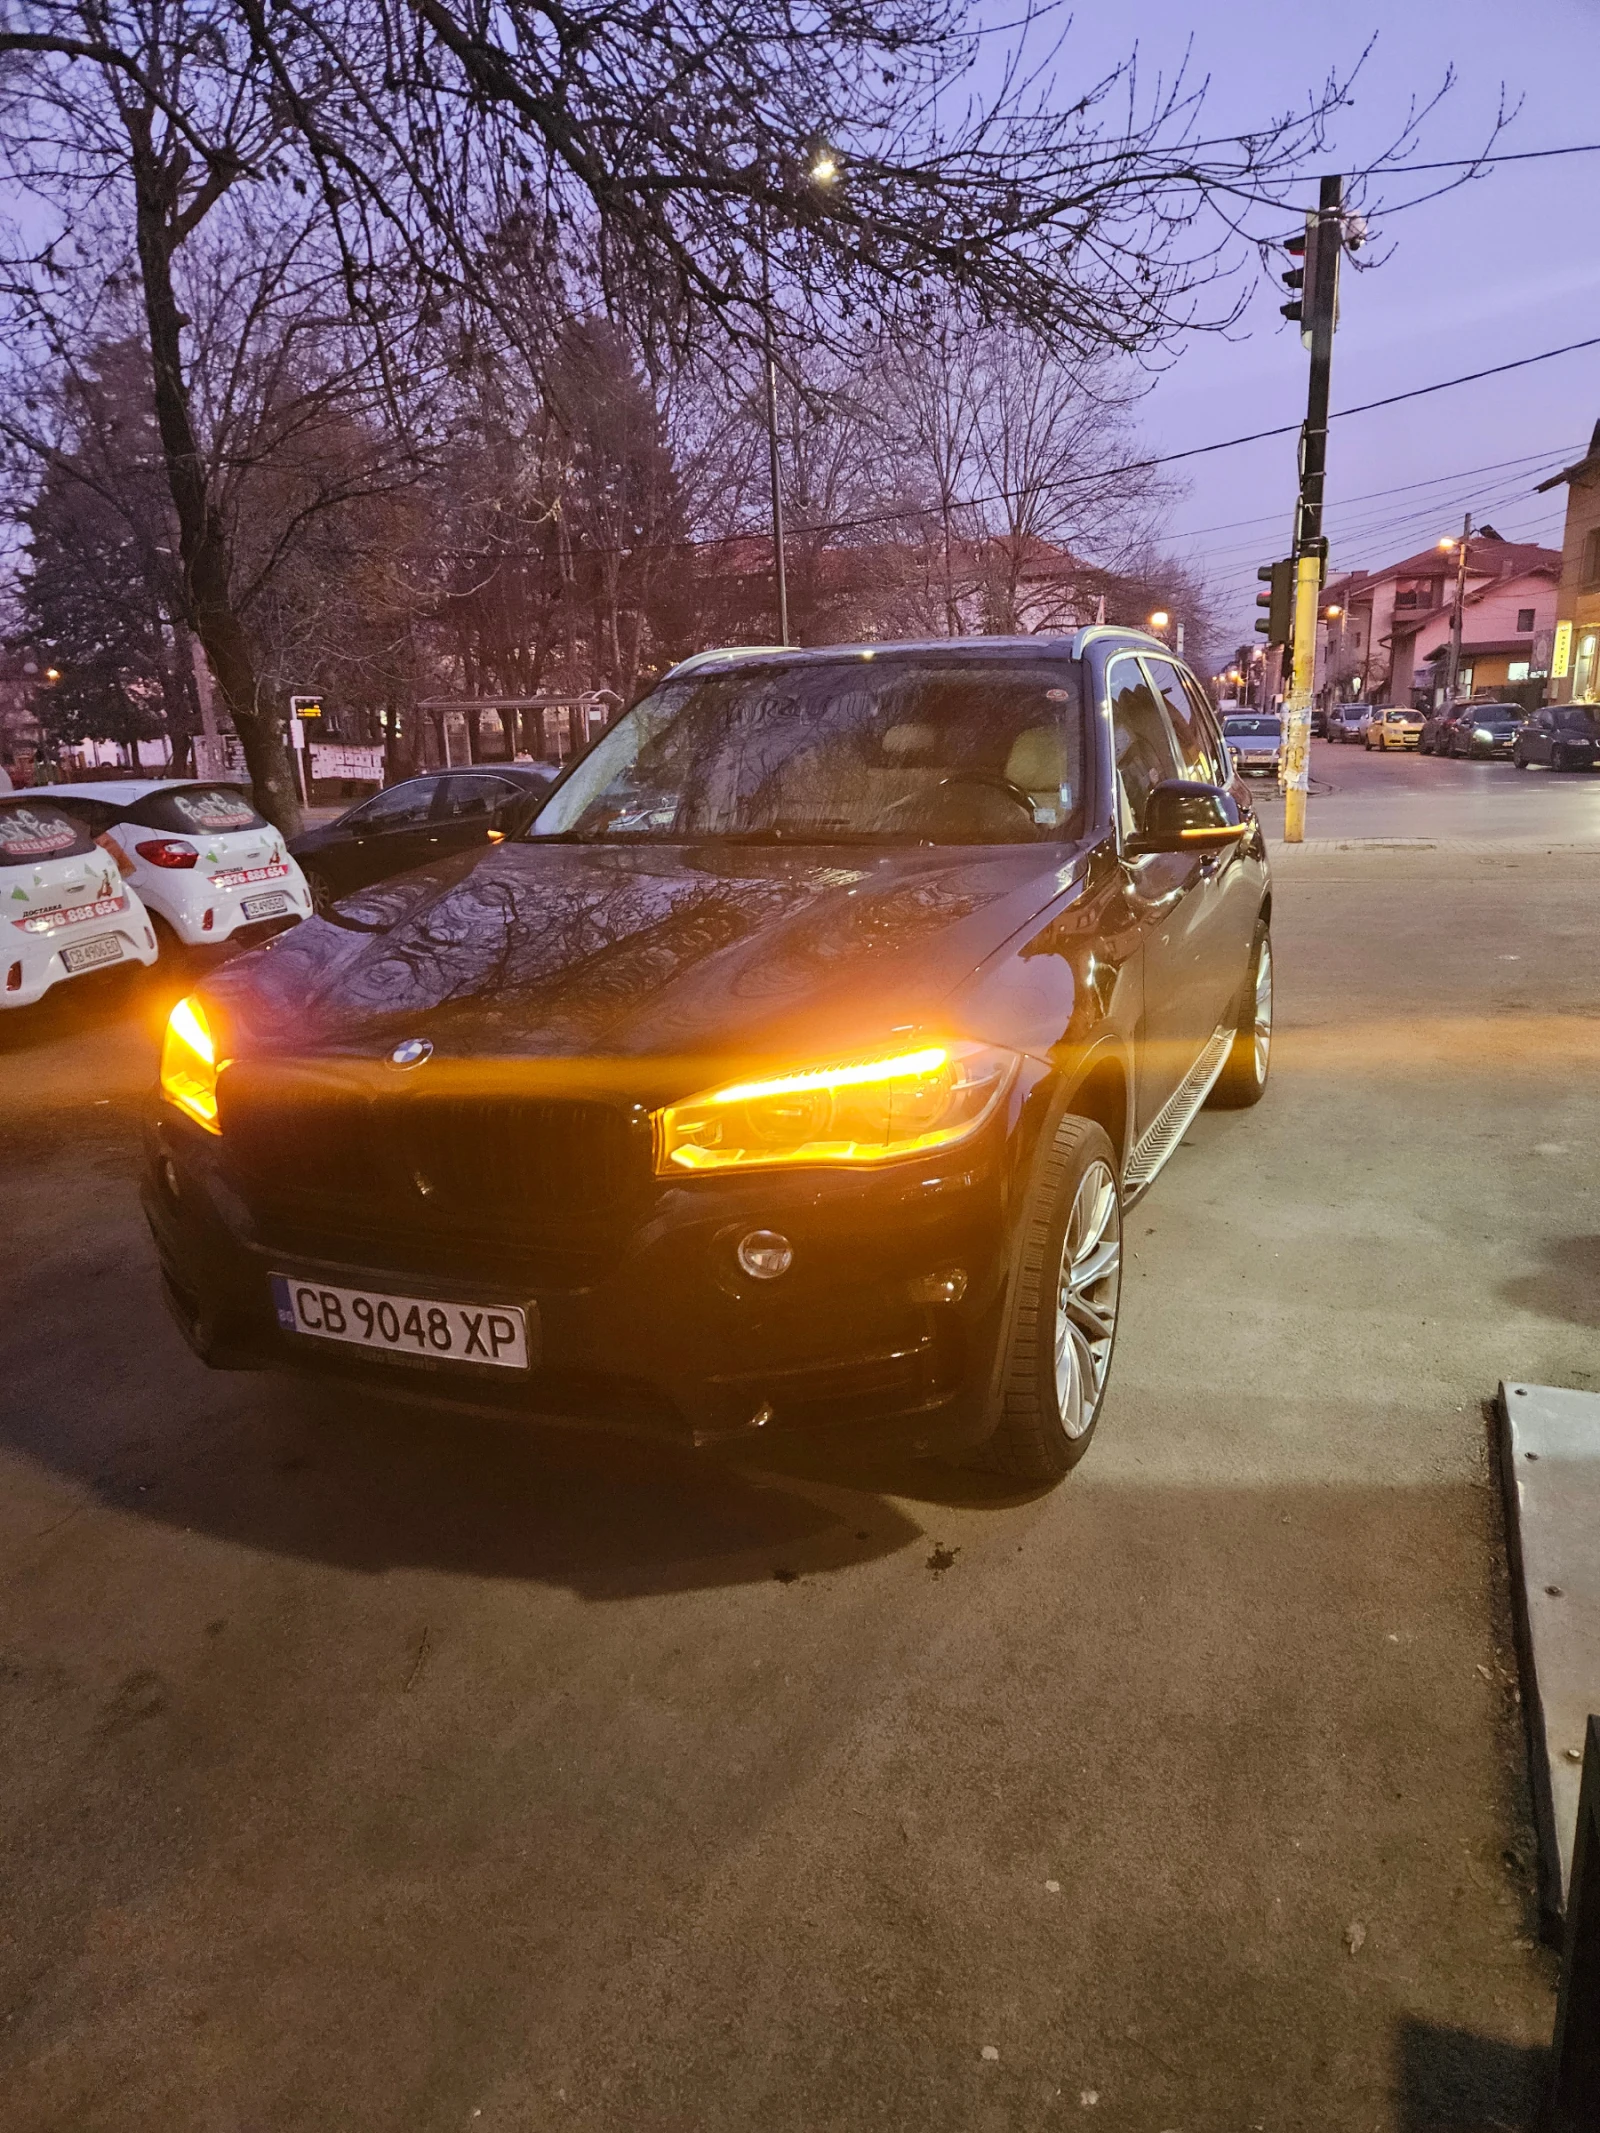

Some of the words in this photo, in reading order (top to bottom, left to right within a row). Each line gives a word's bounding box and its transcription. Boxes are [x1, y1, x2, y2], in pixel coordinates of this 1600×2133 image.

[267, 866, 286, 877] 654
[23, 904, 62, 917] ДОСТАВКА
[67, 906, 94, 922] 888
[95, 900, 119, 915] 654
[296, 1288, 347, 1334] CB
[352, 1297, 452, 1351] 9048
[460, 1310, 516, 1358] XP
